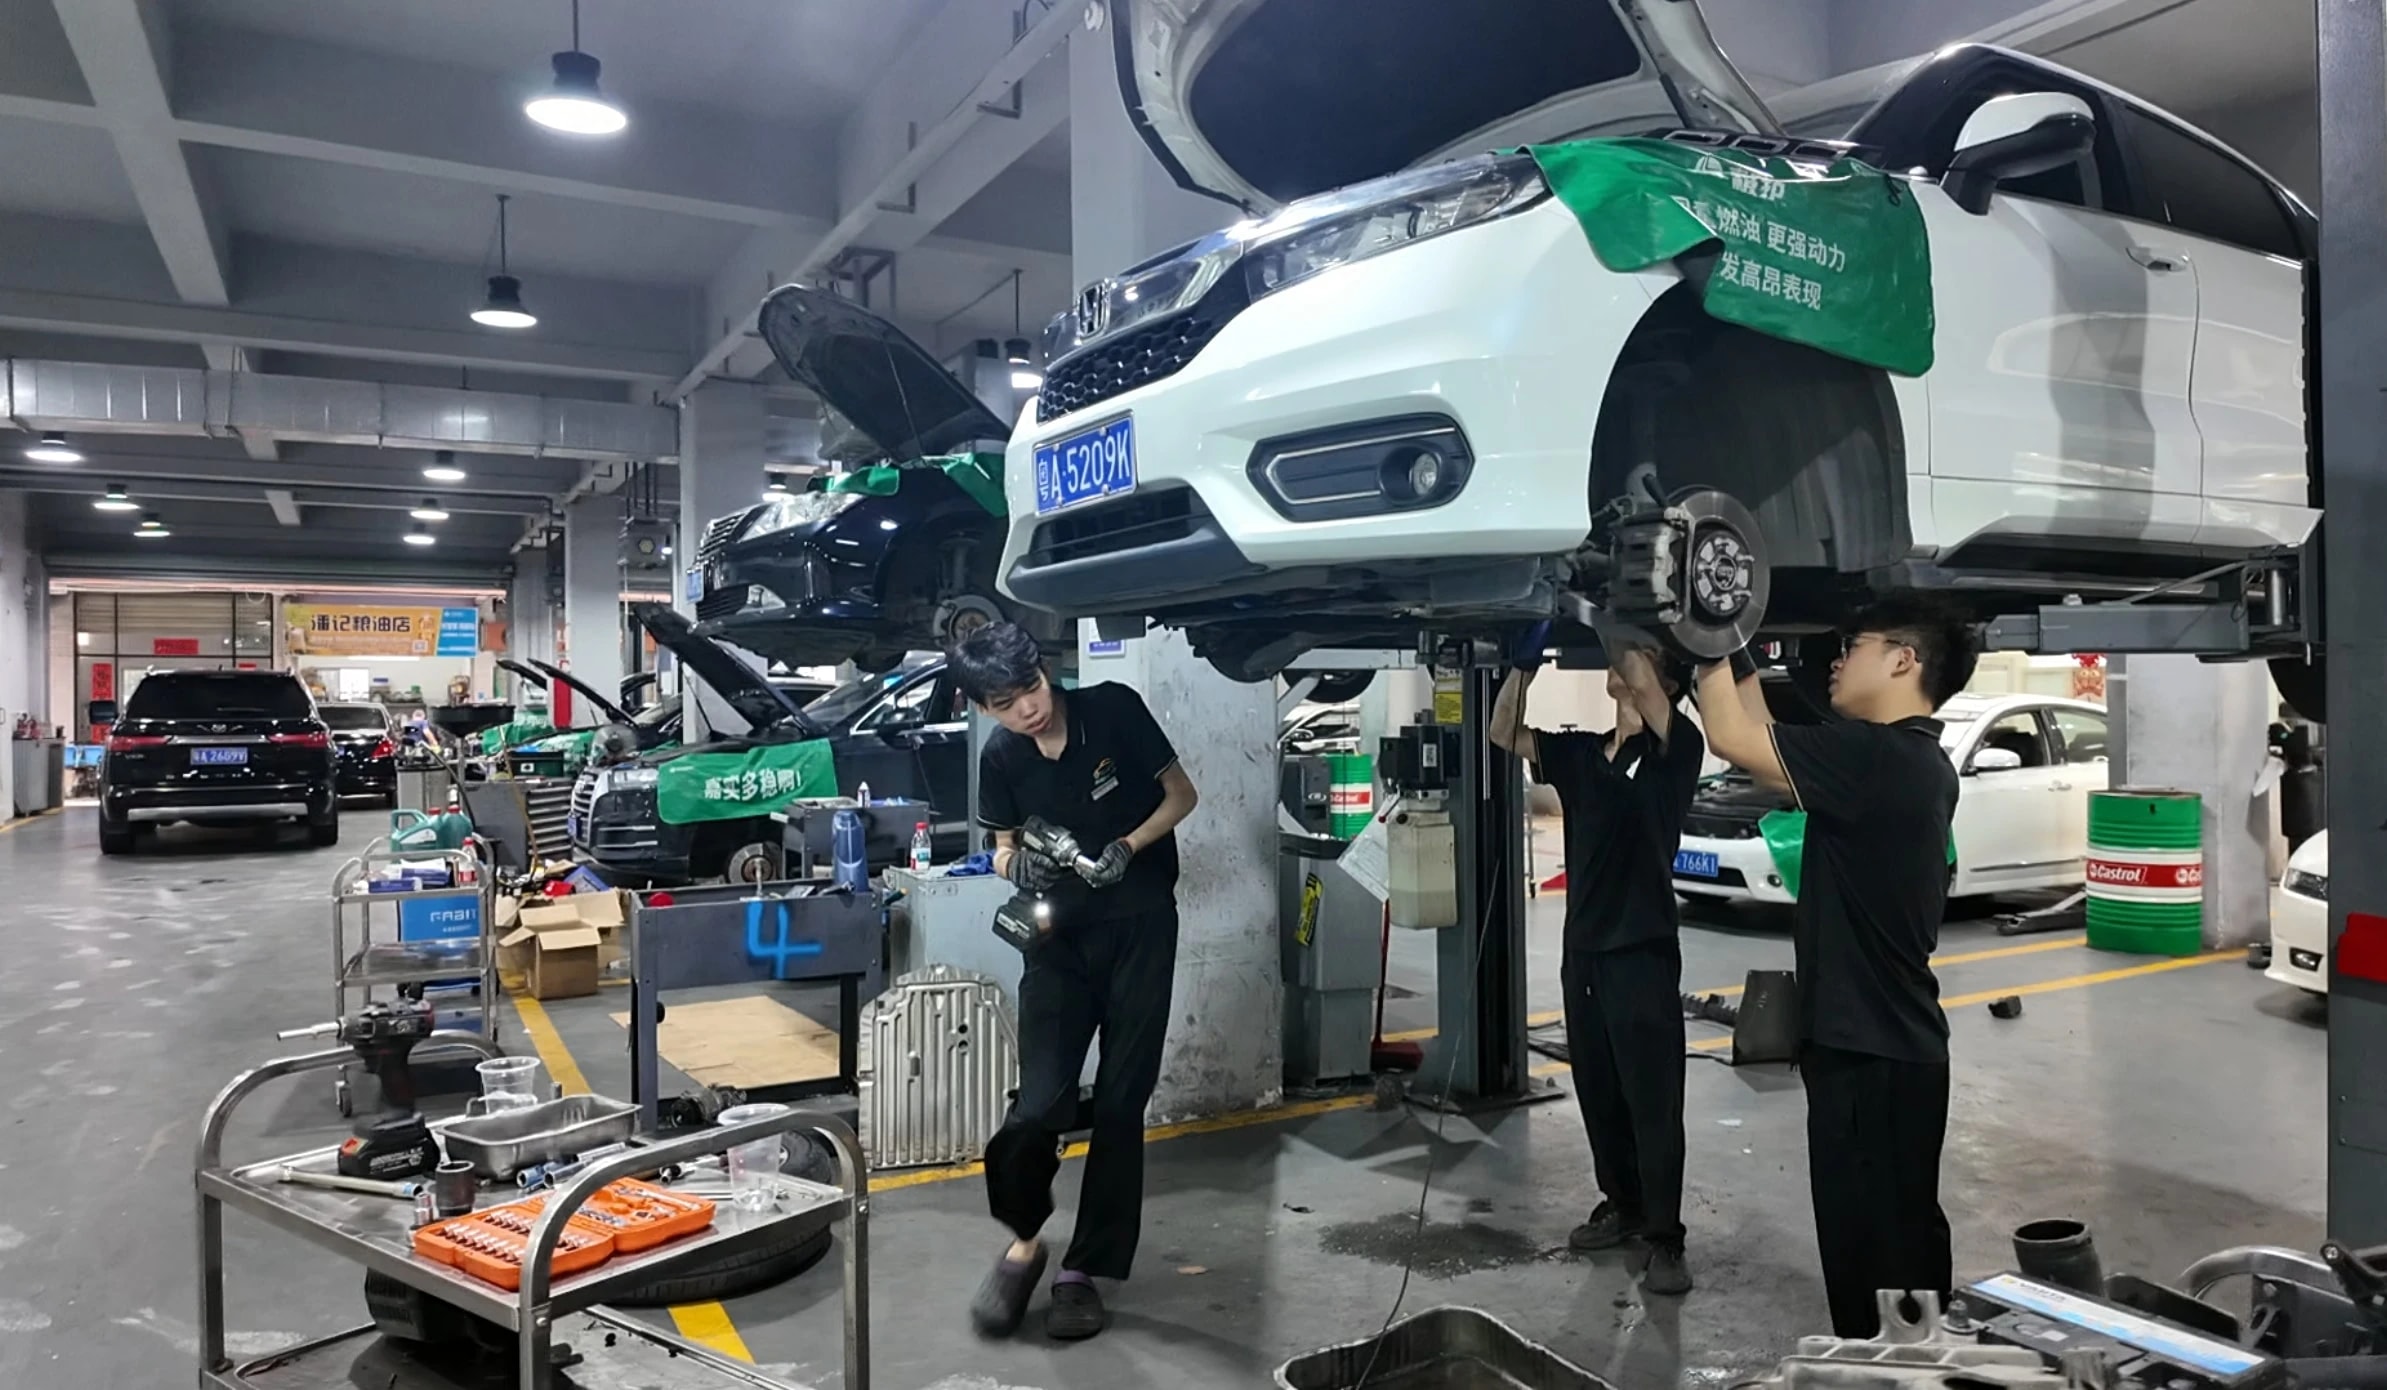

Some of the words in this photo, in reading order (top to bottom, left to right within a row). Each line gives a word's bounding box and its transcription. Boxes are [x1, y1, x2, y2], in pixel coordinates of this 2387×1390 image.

[1766, 220, 1846, 273] 更强动力
[1719, 250, 1822, 310] 发高昂表现
[311, 614, 411, 632] 潘记粮油店
[2097, 864, 2141, 882] Castrol
[747, 901, 822, 979] 4
